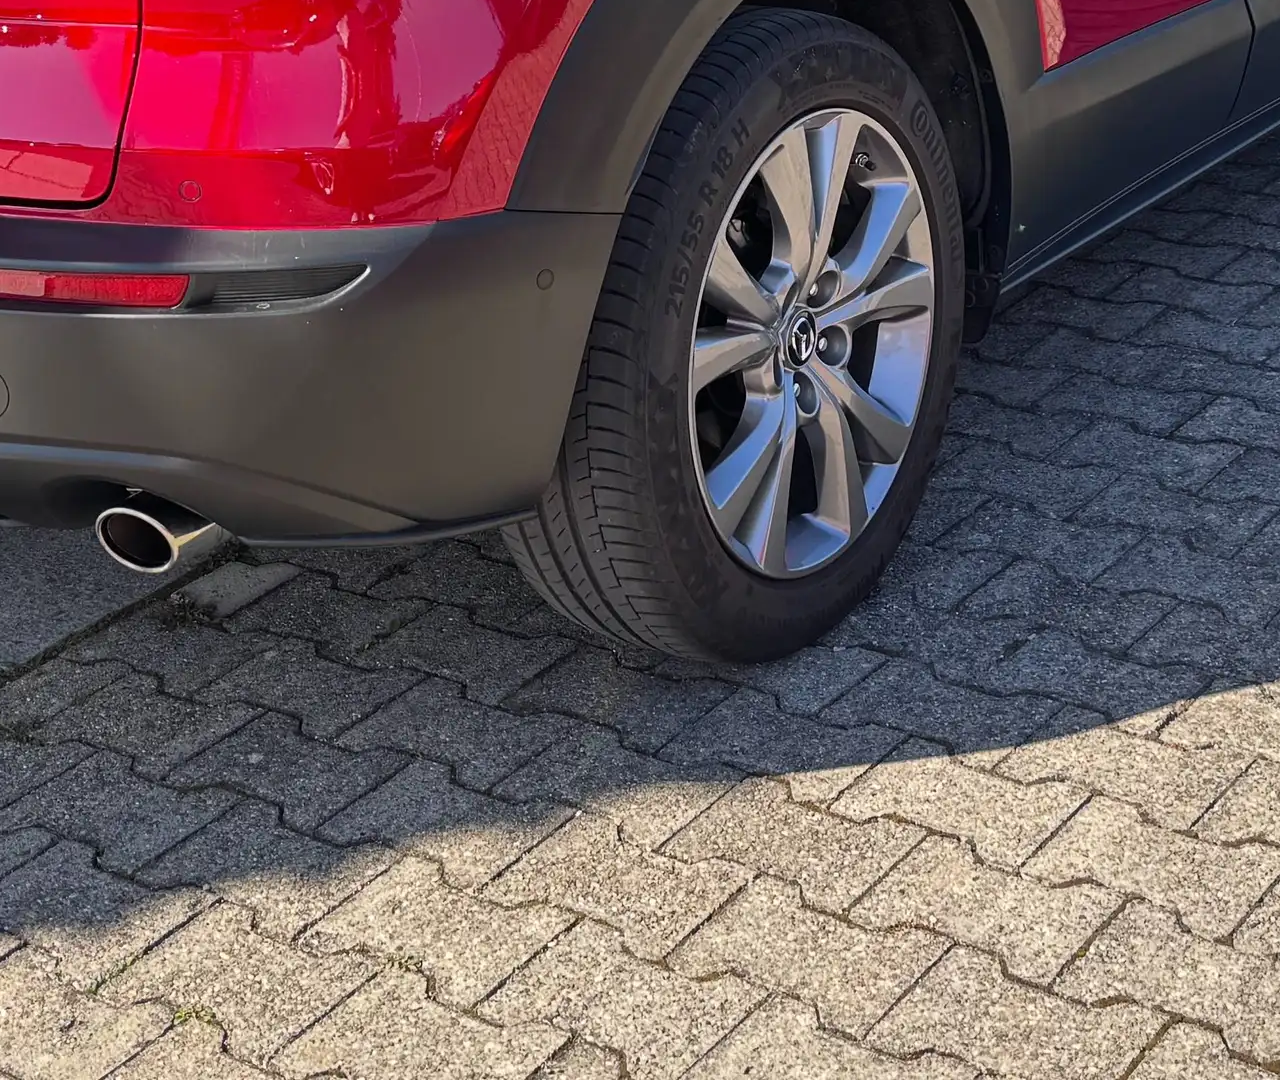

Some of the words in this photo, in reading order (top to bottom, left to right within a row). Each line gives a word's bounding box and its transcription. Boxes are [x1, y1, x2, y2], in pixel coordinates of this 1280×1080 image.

[663, 210, 705, 319] 215/55
[697, 179, 719, 208] R
[711, 145, 735, 178] 18
[730, 117, 751, 147] H
[910, 100, 963, 263] Continental
